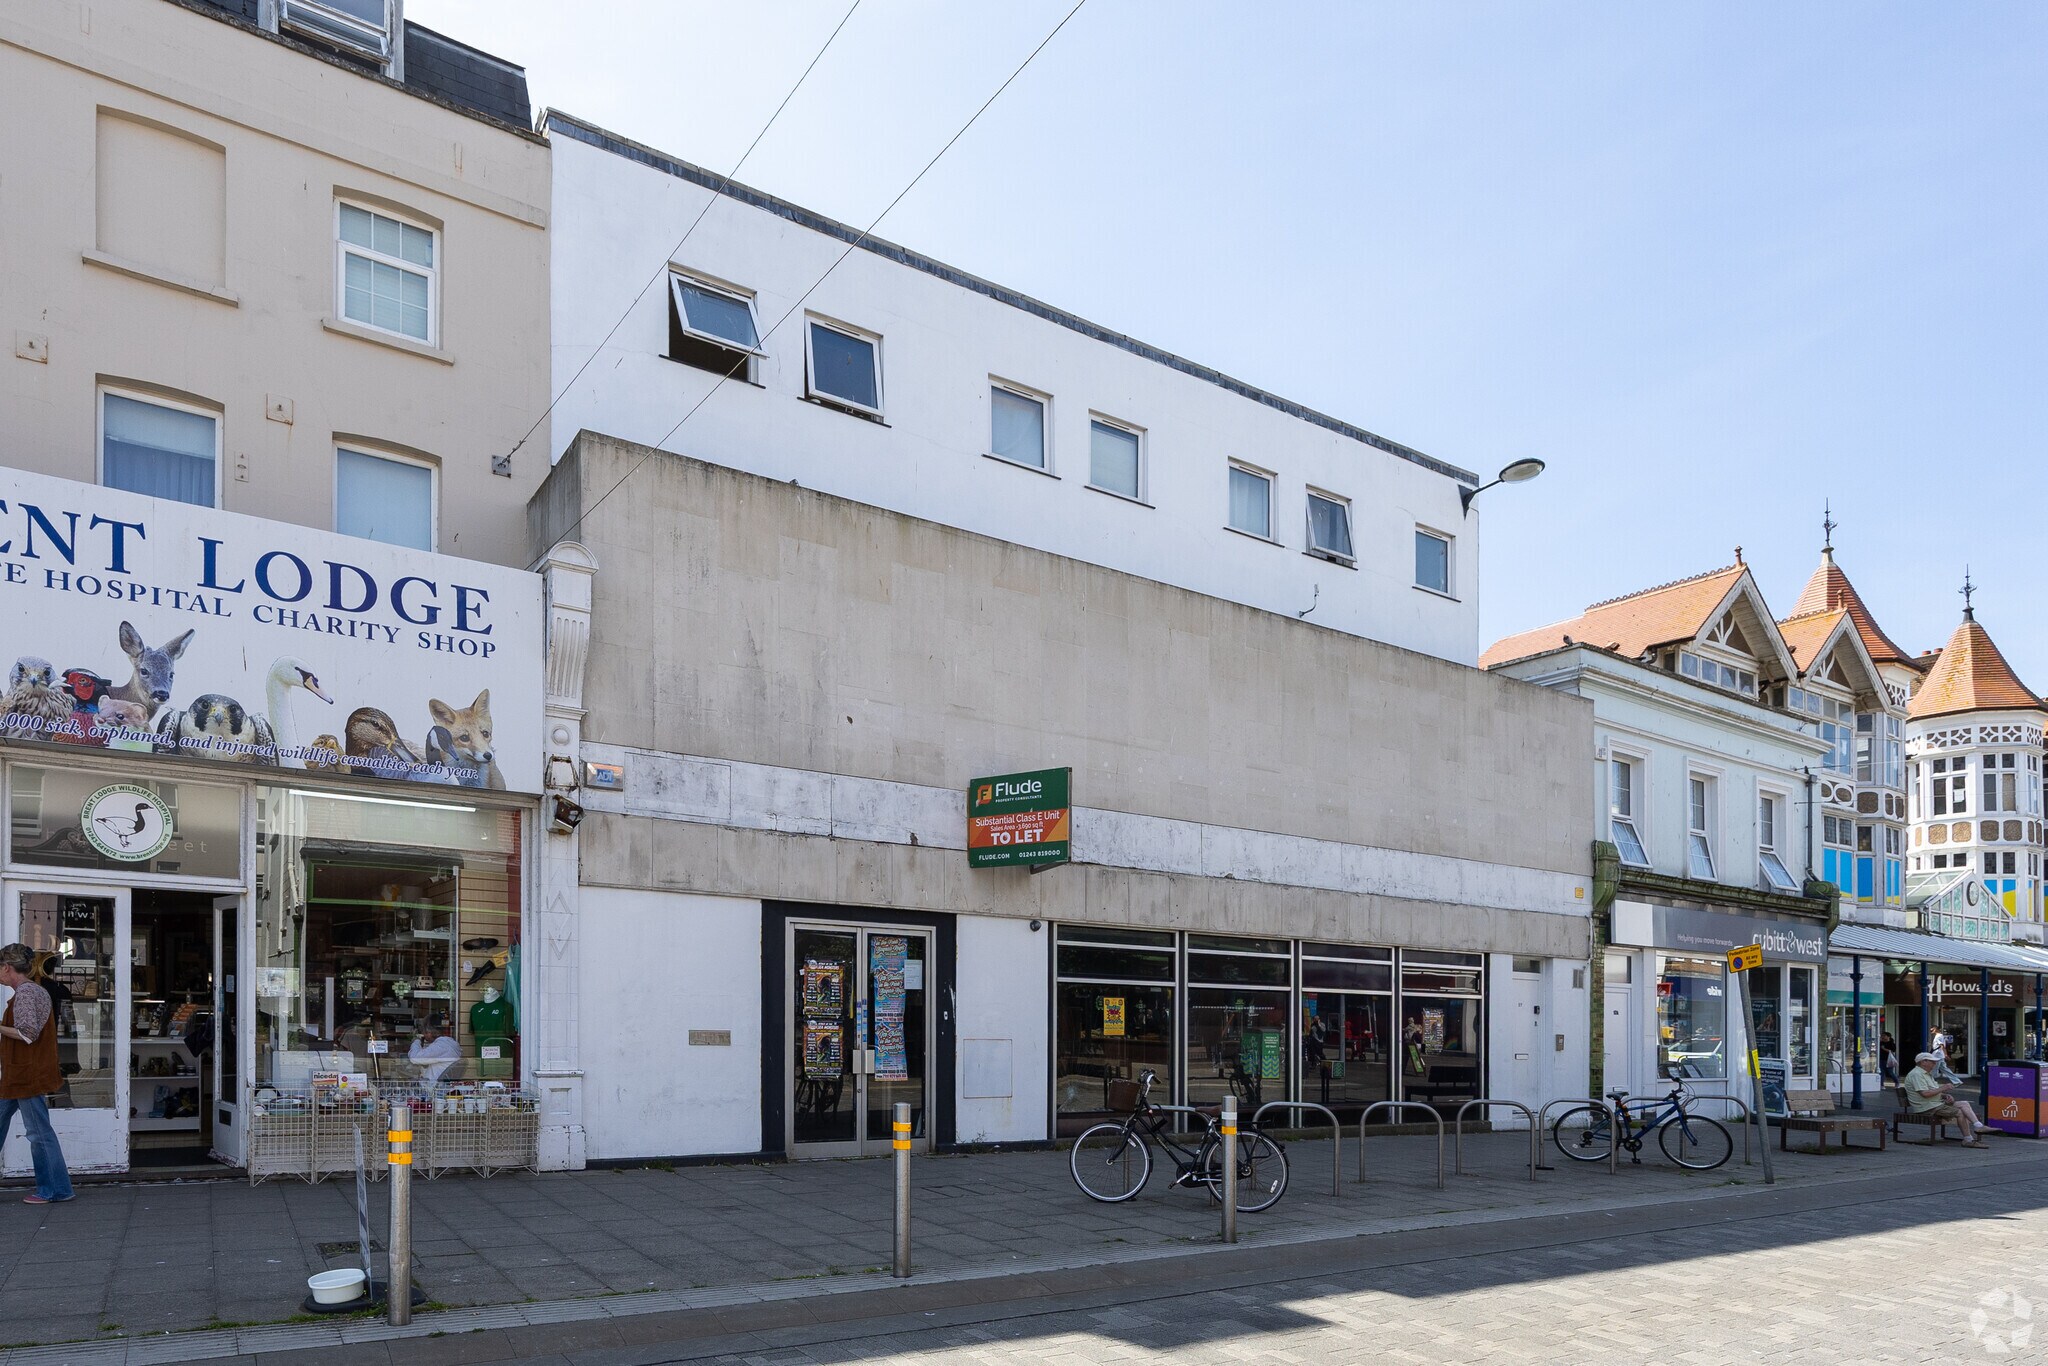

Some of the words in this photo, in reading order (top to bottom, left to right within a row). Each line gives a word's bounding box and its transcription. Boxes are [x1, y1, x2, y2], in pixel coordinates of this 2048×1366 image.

[0, 499, 146, 575] NT
[197, 537, 493, 635] LODGE
[0, 562, 28, 585] E
[44, 568, 232, 618] HOSPITAL
[252, 605, 401, 643] CHARITY
[418, 631, 496, 659] SHOP
[45, 717, 85, 737] sick,
[88, 723, 176, 748] orphaned,
[179, 736, 212, 750] and
[215, 738, 276, 757] injured
[279, 747, 337, 767] wildlife
[341, 755, 410, 771] casualties
[413, 761, 444, 775] each
[444, 766, 478, 780] year.
[995, 780, 1042, 797] Flude
[83, 799, 96, 819] BRENT
[95, 786, 118, 800] LODGE
[118, 785, 153, 799] WILDLIFE
[152, 796, 172, 825] HOSPITAL
[975, 814, 1015, 827] Substantial
[1016, 813, 1036, 823] Class
[1037, 812, 1043, 820] E
[1044, 810, 1060, 820] Unit
[990, 832, 1011, 845] TO
[1014, 829, 1044, 844] LET
[978, 853, 1010, 861] FLUDE.COM
[1677, 934, 1693, 943] Helping
[1941, 978, 2013, 995] Howad's
